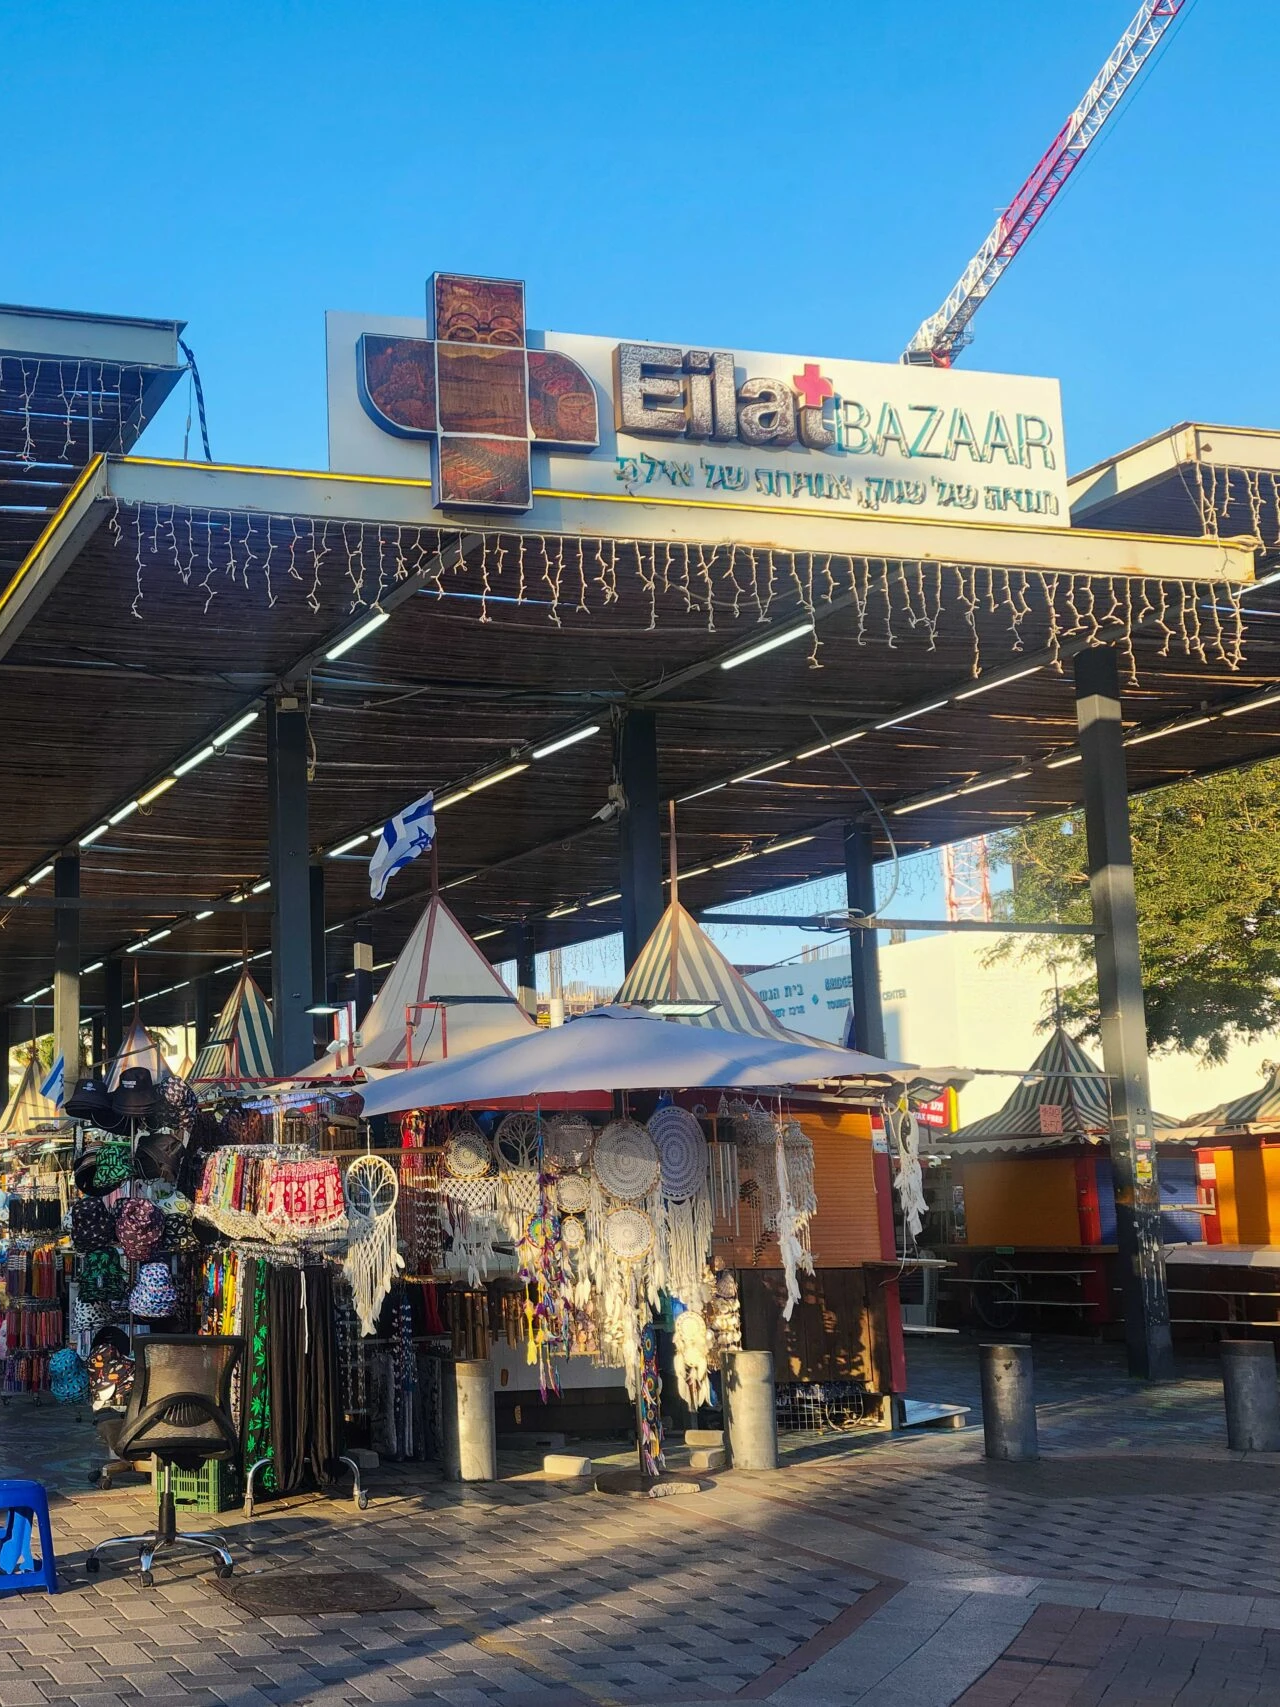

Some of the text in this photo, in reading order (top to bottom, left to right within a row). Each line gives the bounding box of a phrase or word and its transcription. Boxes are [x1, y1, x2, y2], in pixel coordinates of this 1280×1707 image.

[615, 342, 1056, 471] Eilat BAZAAR
[614, 451, 692, 488] אילת
[700, 457, 749, 491] של
[930, 475, 979, 510] של
[783, 983, 805, 998] בית
[882, 988, 907, 1001] CENTER
